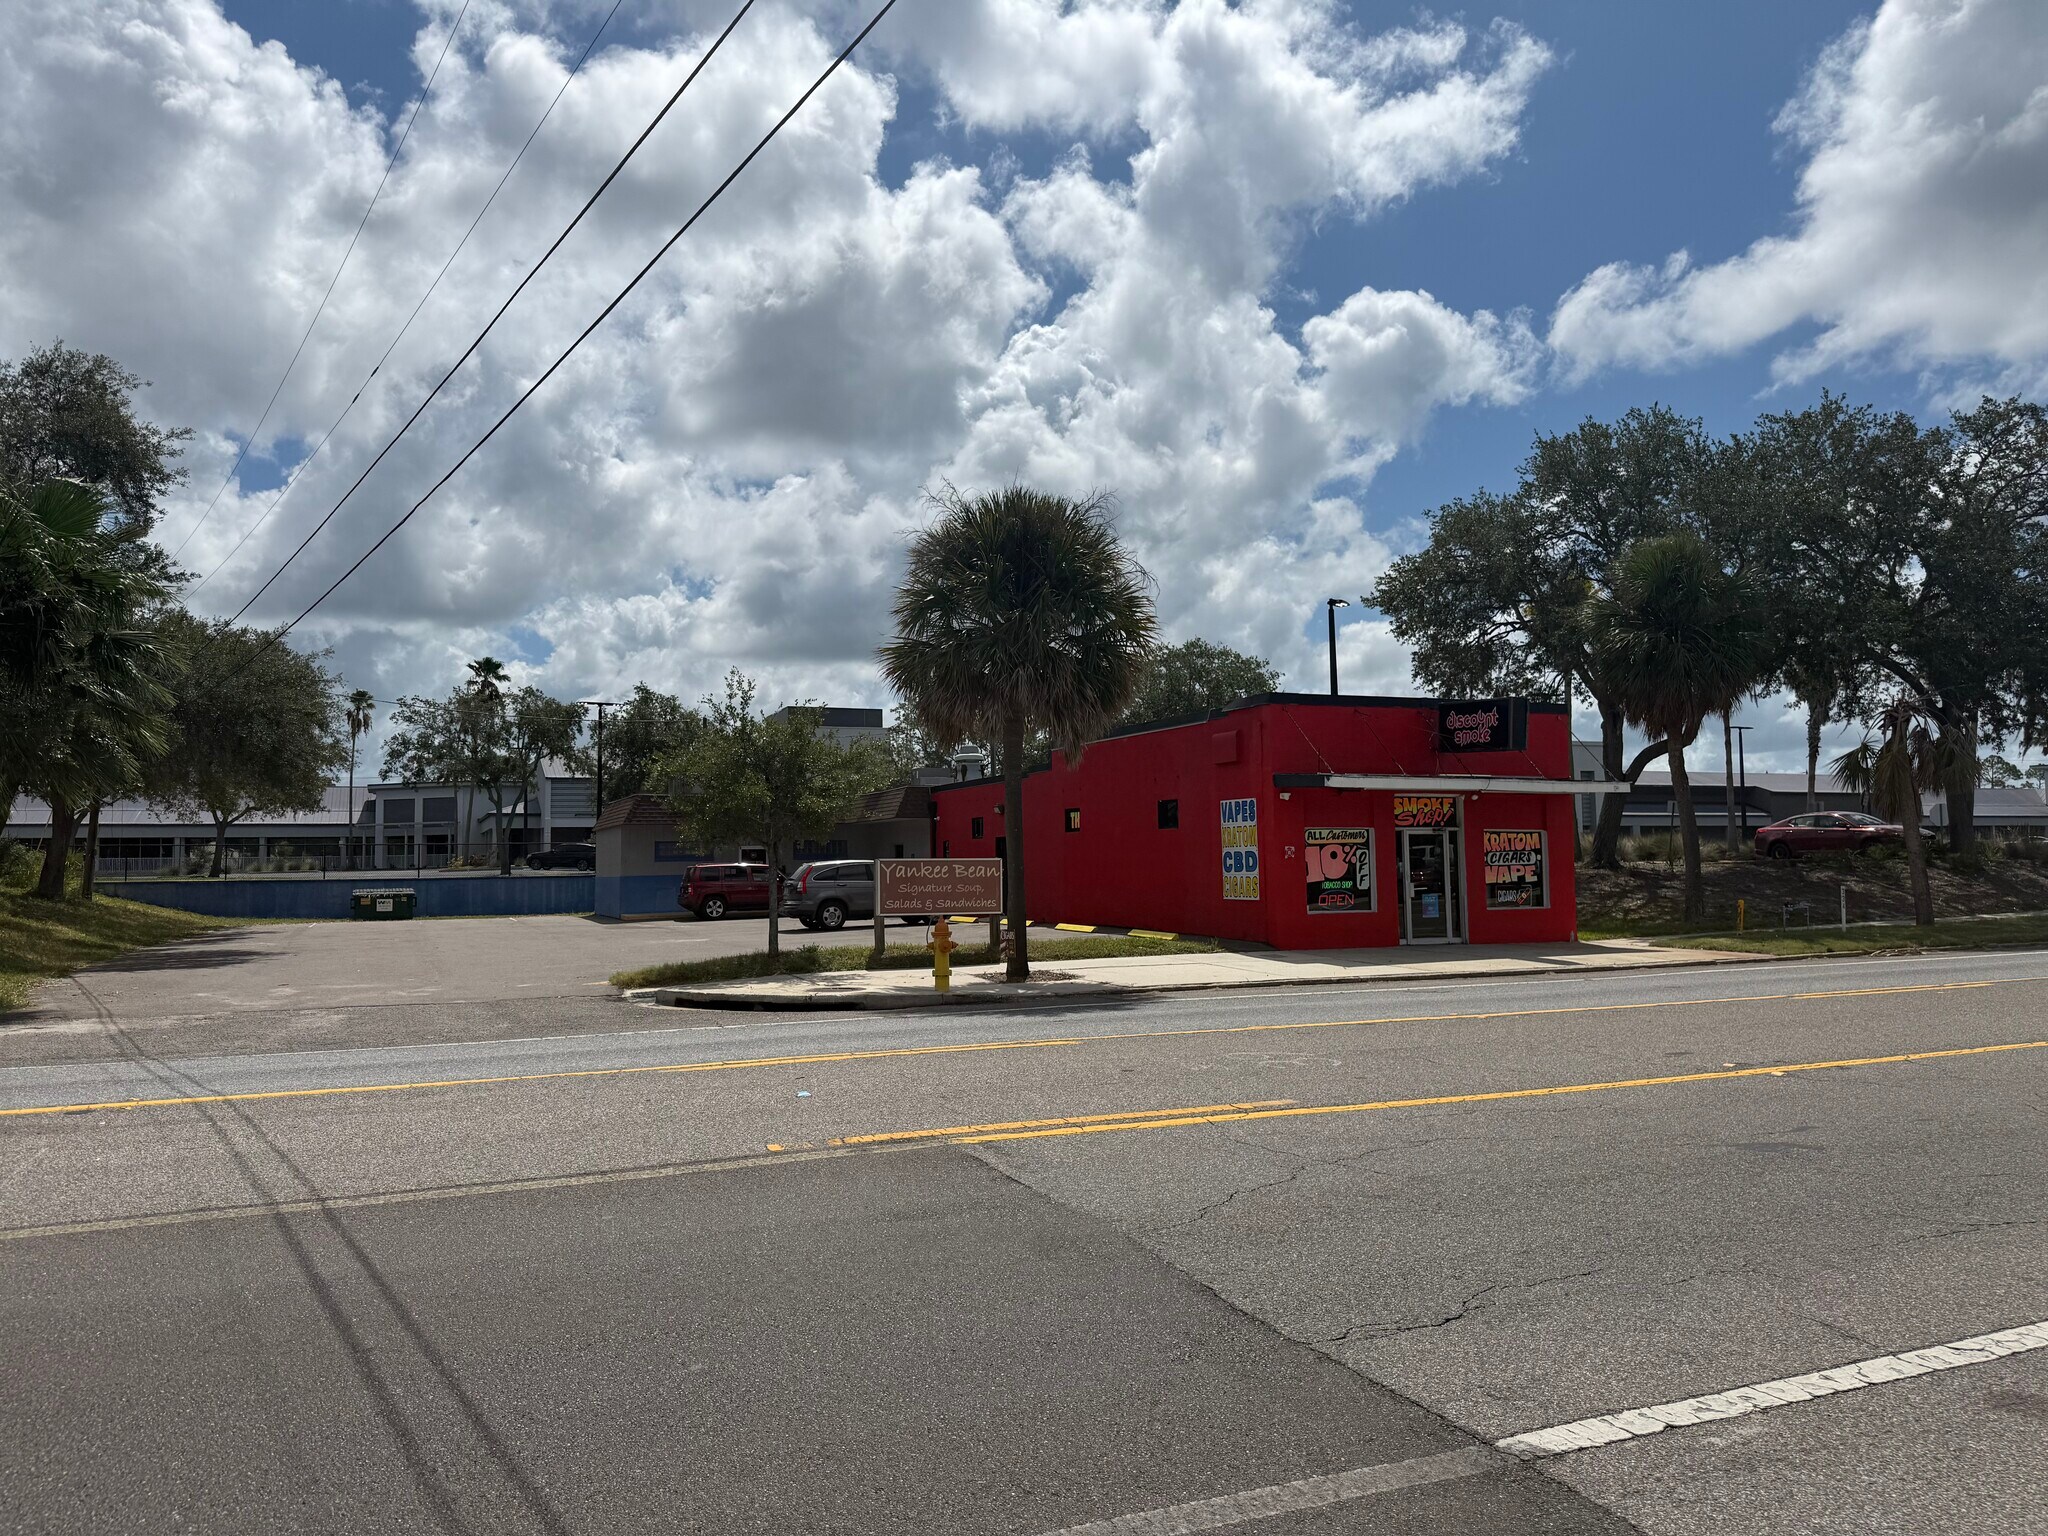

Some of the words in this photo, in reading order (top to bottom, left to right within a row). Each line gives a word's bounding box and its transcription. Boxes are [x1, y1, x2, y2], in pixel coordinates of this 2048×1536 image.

[1446, 706, 1499, 729] discount
[1454, 723, 1491, 746] smoke
[1221, 799, 1256, 823] VAPES
[1394, 797, 1454, 815] SMOKE
[1222, 825, 1257, 848] KRATOM
[1307, 831, 1325, 840] ALL
[1483, 832, 1540, 852] KRATOM
[1223, 851, 1257, 873] CBD
[1304, 844, 1356, 883] 10%
[1490, 852, 1532, 864] CIGARS
[881, 862, 949, 884] Yankee
[952, 864, 1000, 878] Bean
[1358, 851, 1369, 887] OFF
[1485, 865, 1537, 884] VAPE
[898, 882, 952, 895] Signature
[1223, 876, 1258, 898] CIGARS
[1341, 880, 1353, 889] SHOP
[884, 898, 922, 909] Salads
[925, 900, 933, 910] &
[936, 898, 996, 908] Sandwiches
[1318, 894, 1354, 906] OPEN
